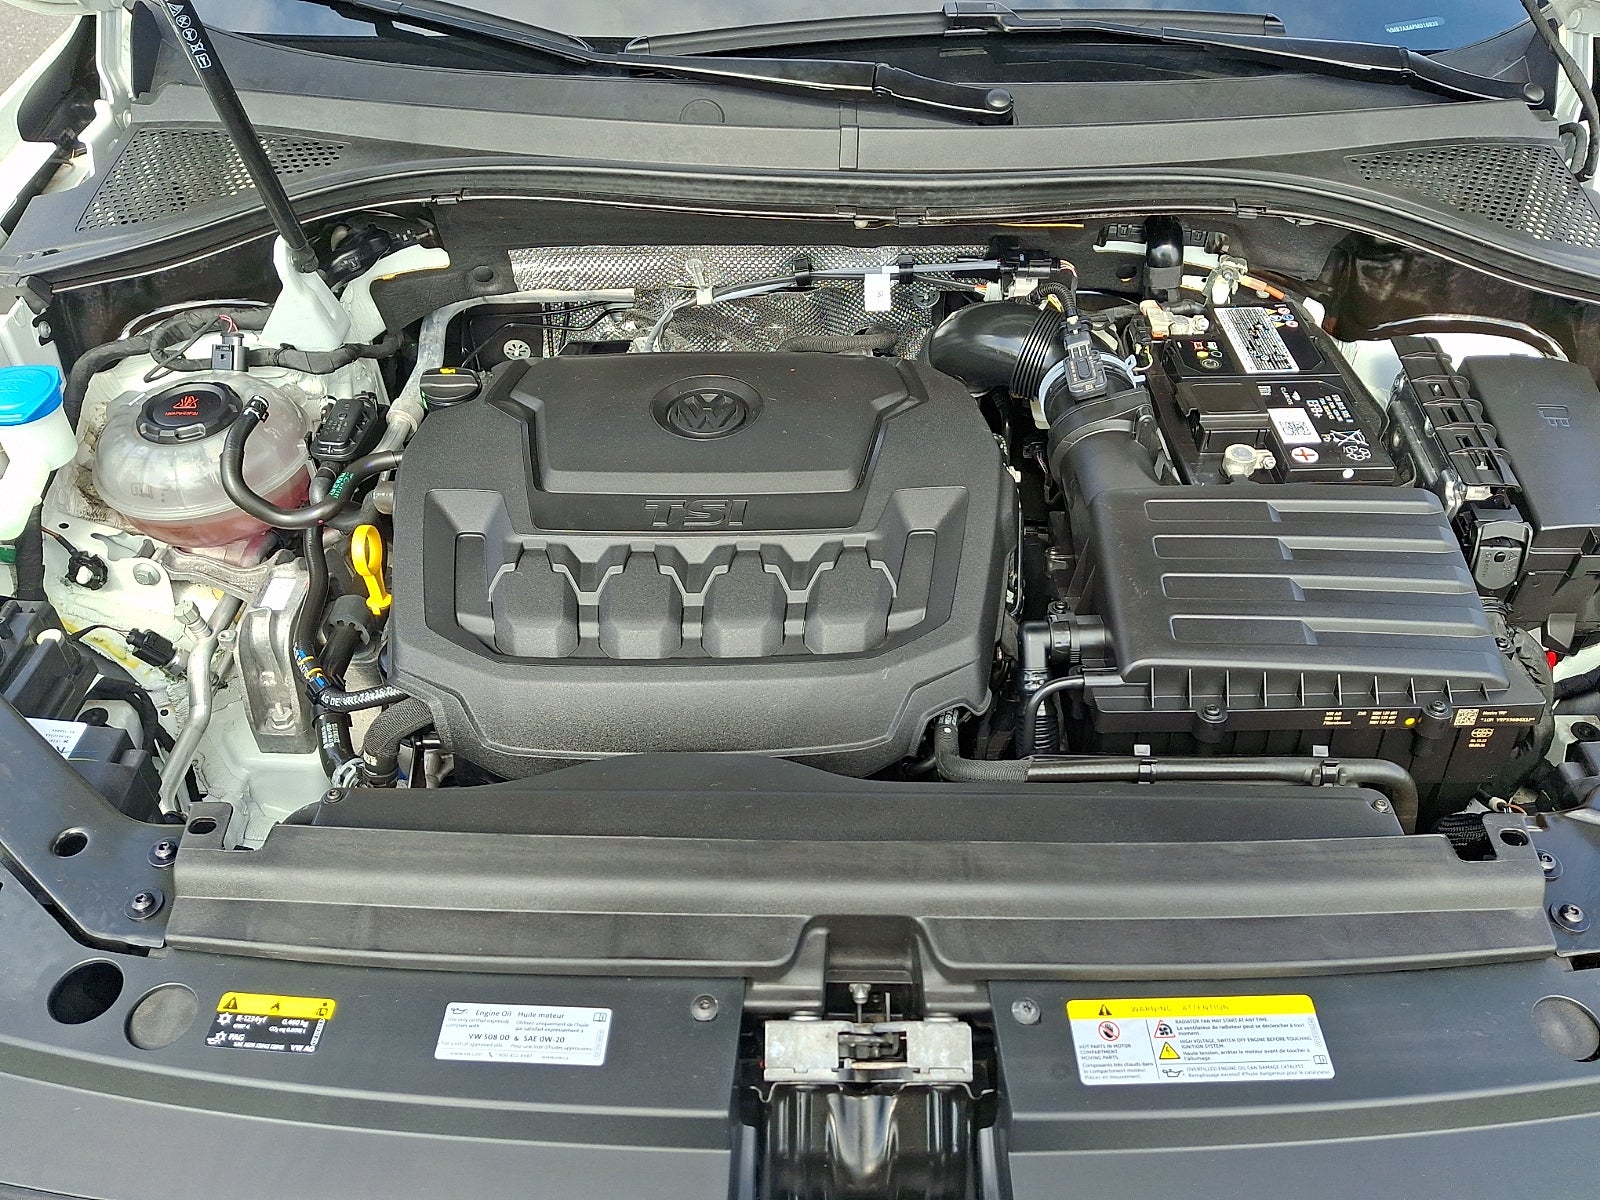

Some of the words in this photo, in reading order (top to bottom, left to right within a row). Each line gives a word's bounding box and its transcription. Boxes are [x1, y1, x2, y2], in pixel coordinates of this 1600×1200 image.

[1280, 387, 1294, 405] CLARIOS
[1306, 400, 1324, 418] EFB+
[645, 500, 749, 526] TSI
[228, 1033, 246, 1041] PAG
